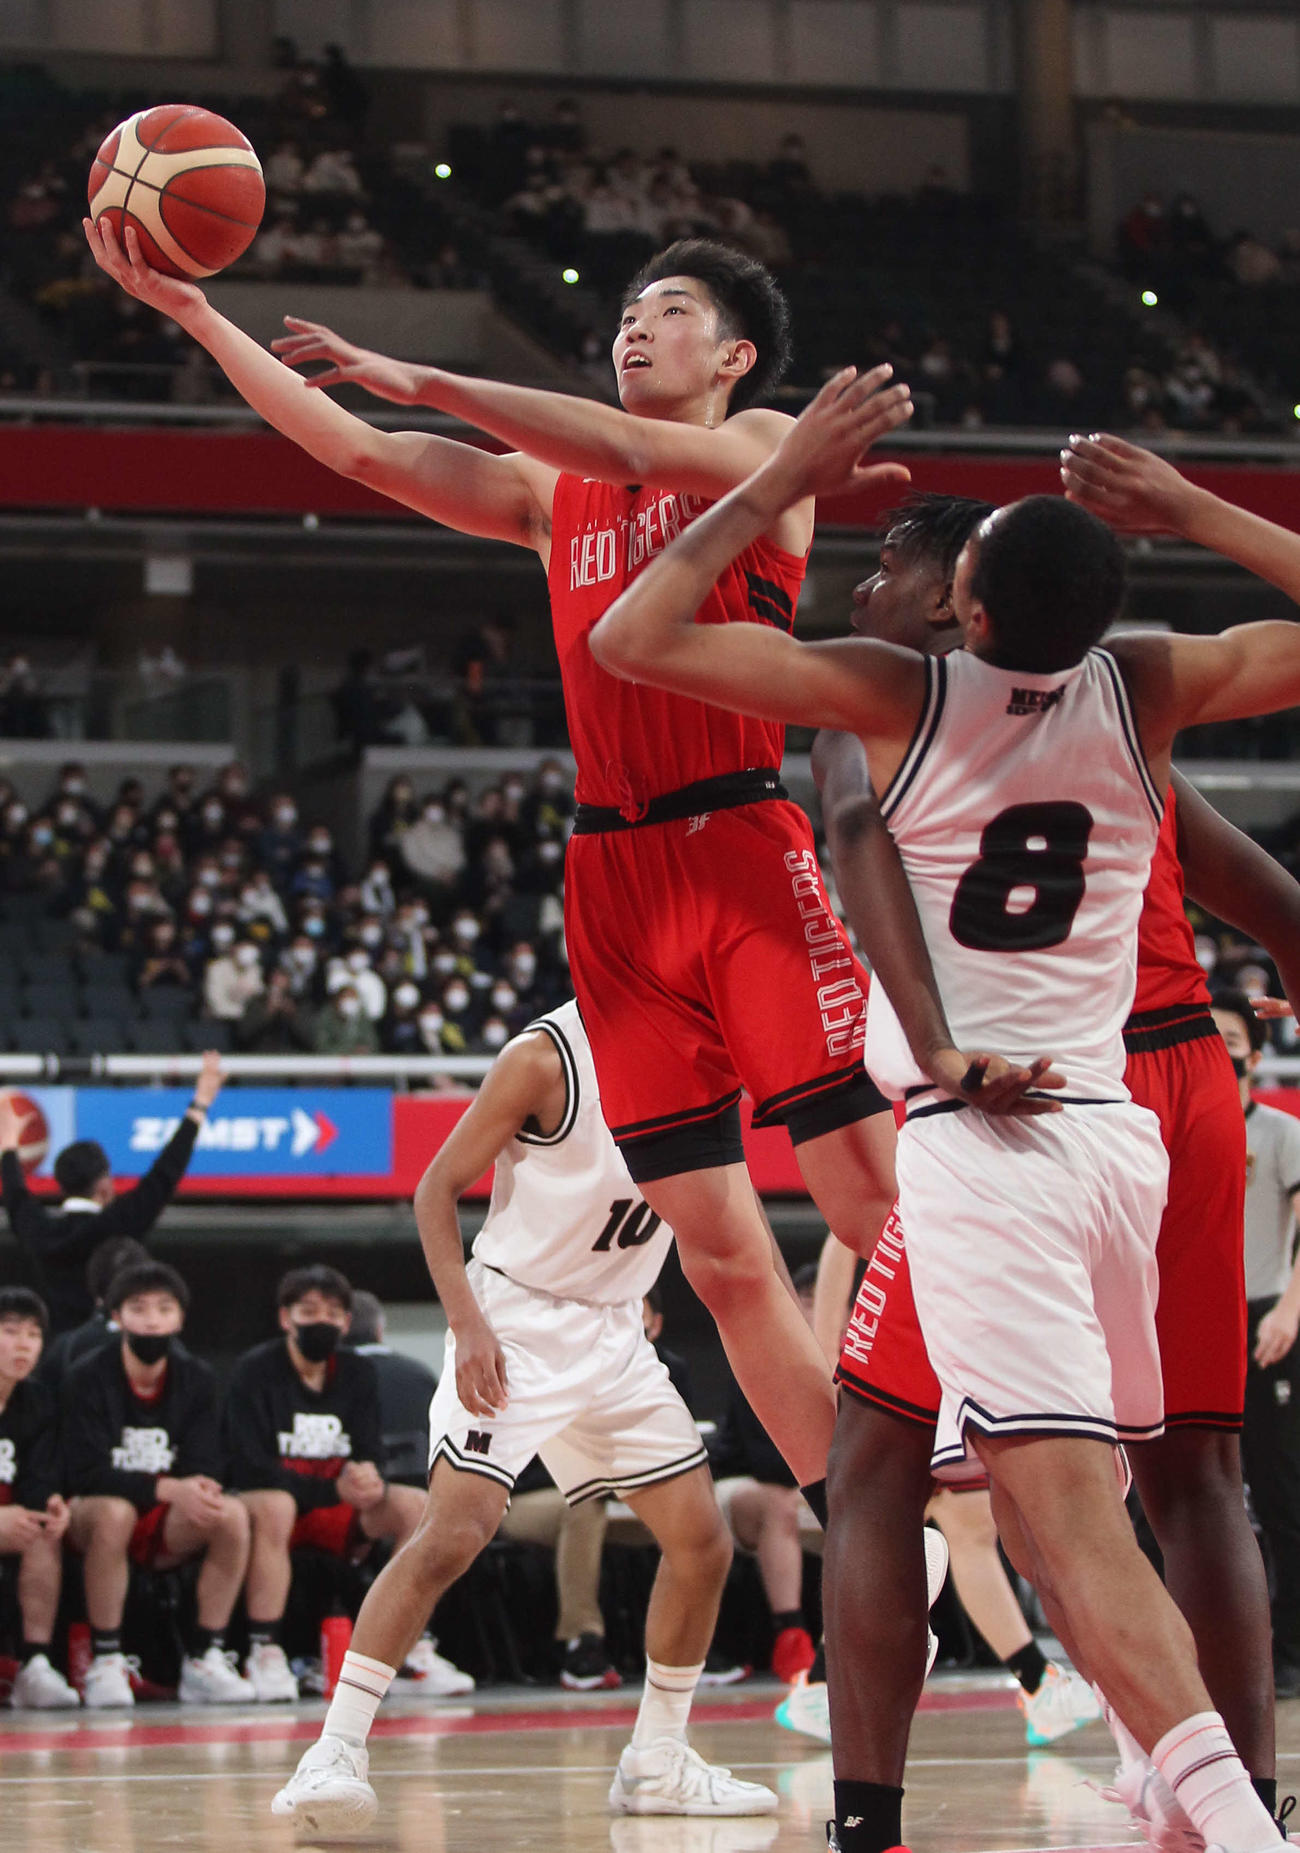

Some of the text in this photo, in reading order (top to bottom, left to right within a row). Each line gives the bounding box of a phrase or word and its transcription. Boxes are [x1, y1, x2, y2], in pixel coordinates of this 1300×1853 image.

[570, 528, 616, 592] RED
[949, 800, 1094, 952] 8
[784, 849, 868, 1057] RED TIGERS
[591, 1198, 662, 1252] 10
[844, 1203, 906, 1364] RED TIG
[464, 1429, 492, 1456] M
